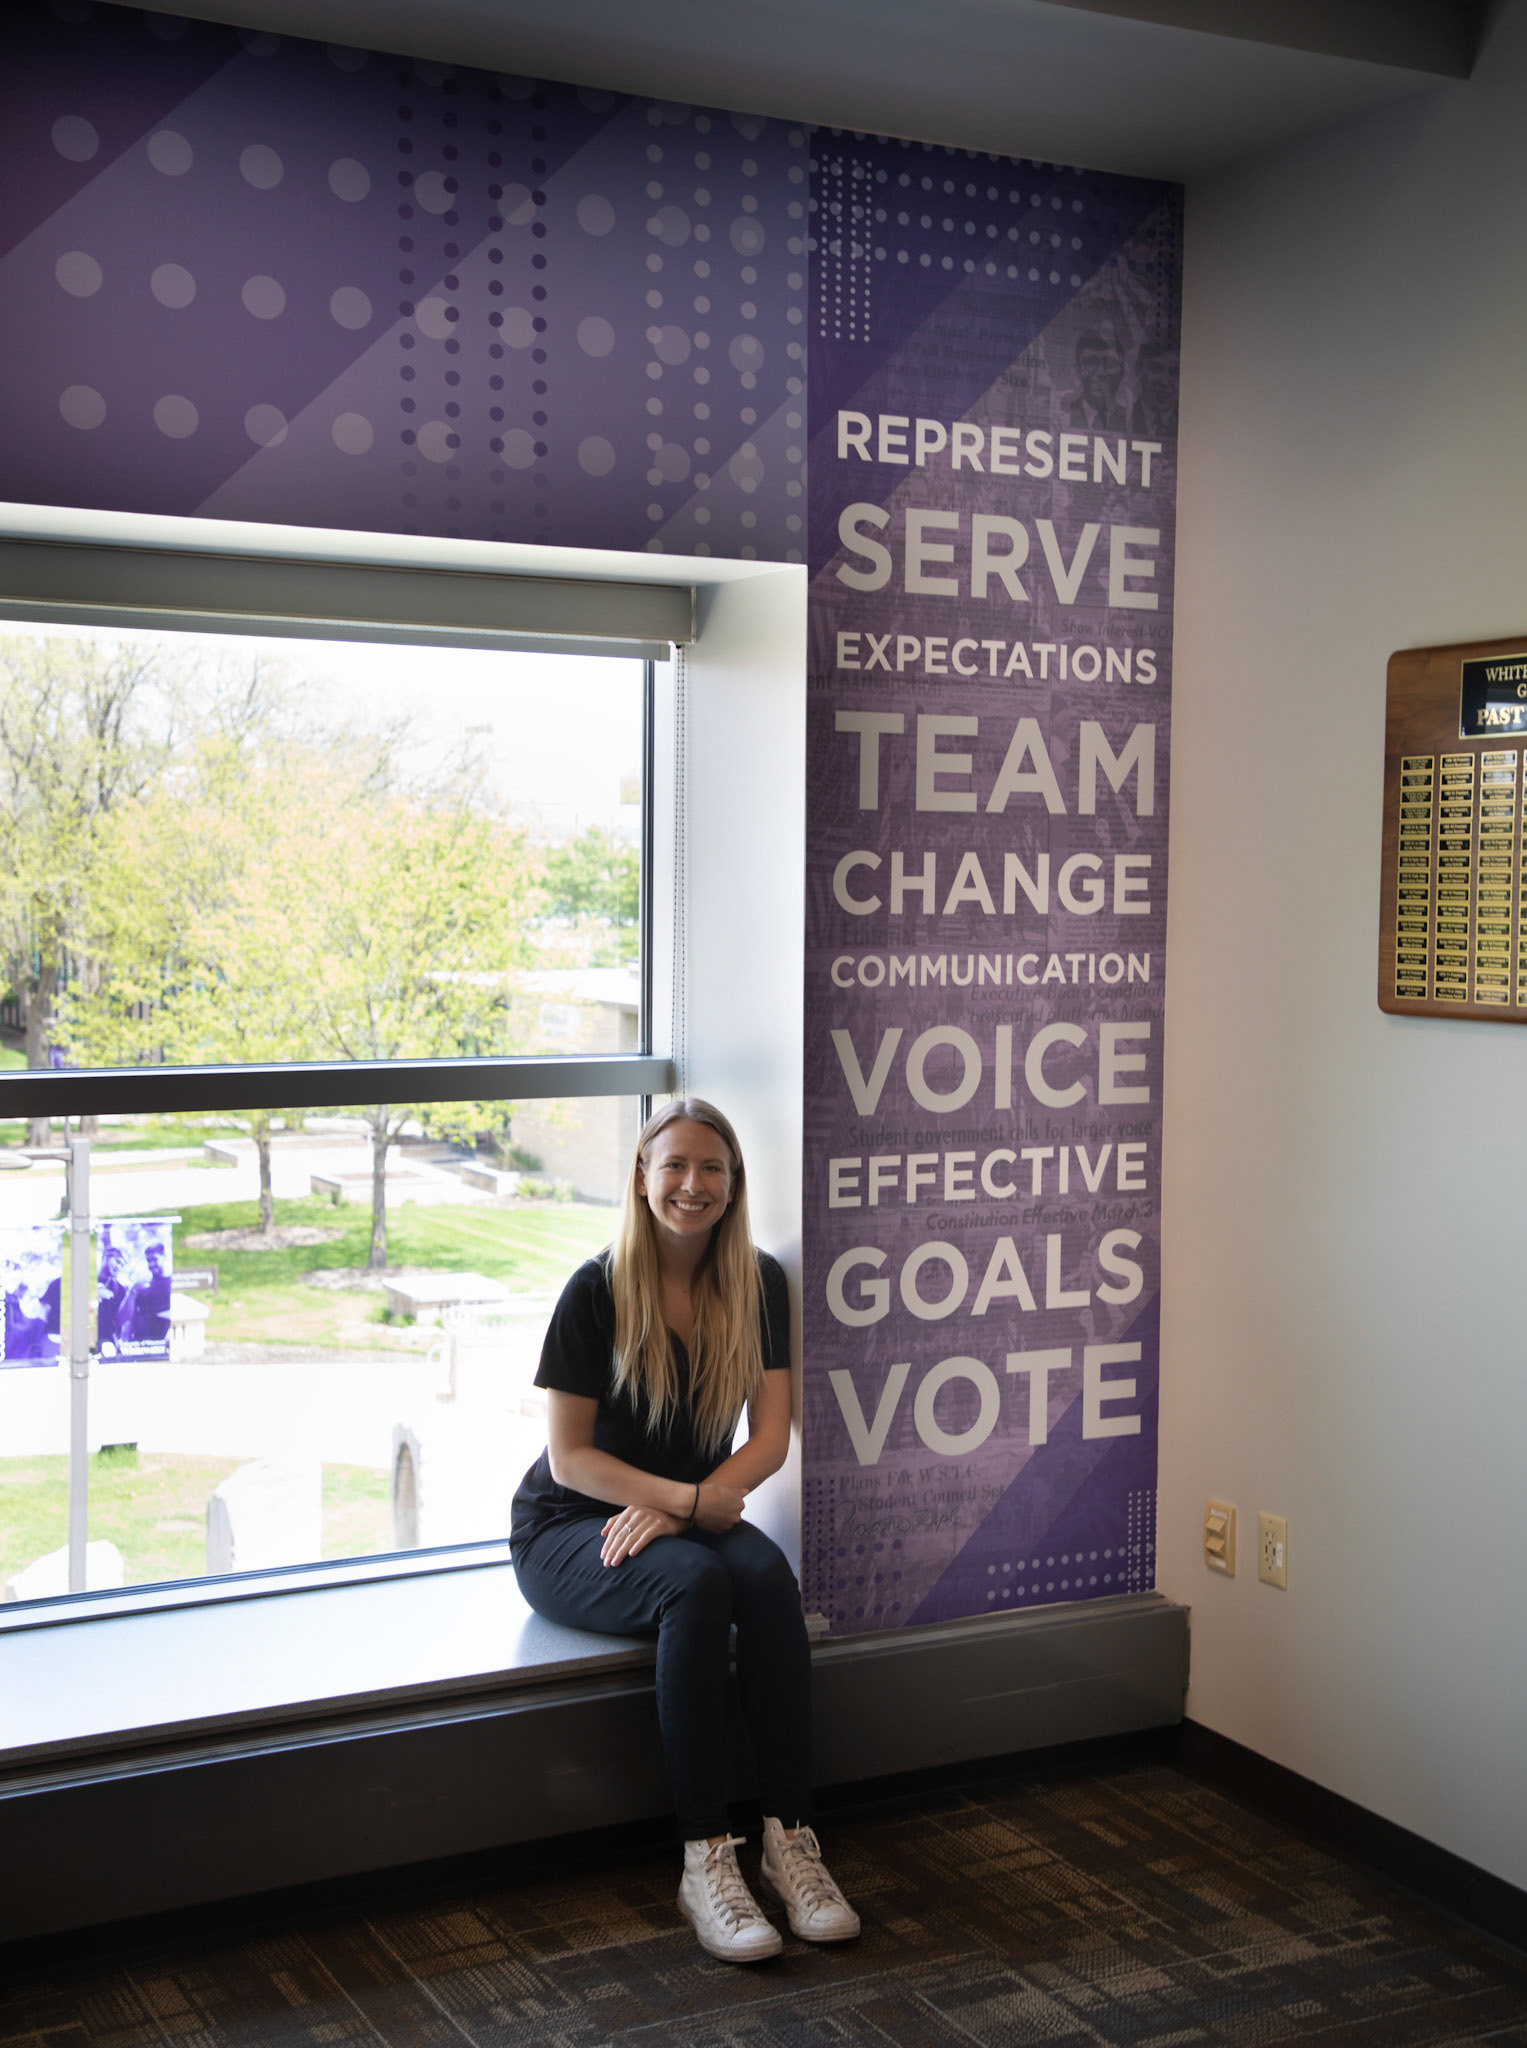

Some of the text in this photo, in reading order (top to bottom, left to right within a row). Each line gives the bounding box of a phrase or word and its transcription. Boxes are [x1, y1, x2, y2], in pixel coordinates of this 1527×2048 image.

[837, 409, 1162, 488] REPRESENT
[834, 501, 1160, 610] SERVE
[836, 631, 1157, 685] EXPECTATIONS
[1476, 705, 1524, 726] PAST
[834, 710, 1156, 817] TEAM
[832, 849, 1152, 916] CHANGE
[830, 952, 1150, 988] COMMUNICATION
[830, 1021, 1151, 1117] VOICE
[849, 1118, 1153, 1149] Student government calls for larger voice
[828, 1142, 1147, 1209] EFFECTIVE
[926, 1209, 1019, 1231] Constitution
[1022, 1204, 1087, 1225] Effective
[825, 1228, 1144, 1328] GOALS
[827, 1341, 1142, 1465] VOTE
[858, 1495, 917, 1512] Student
